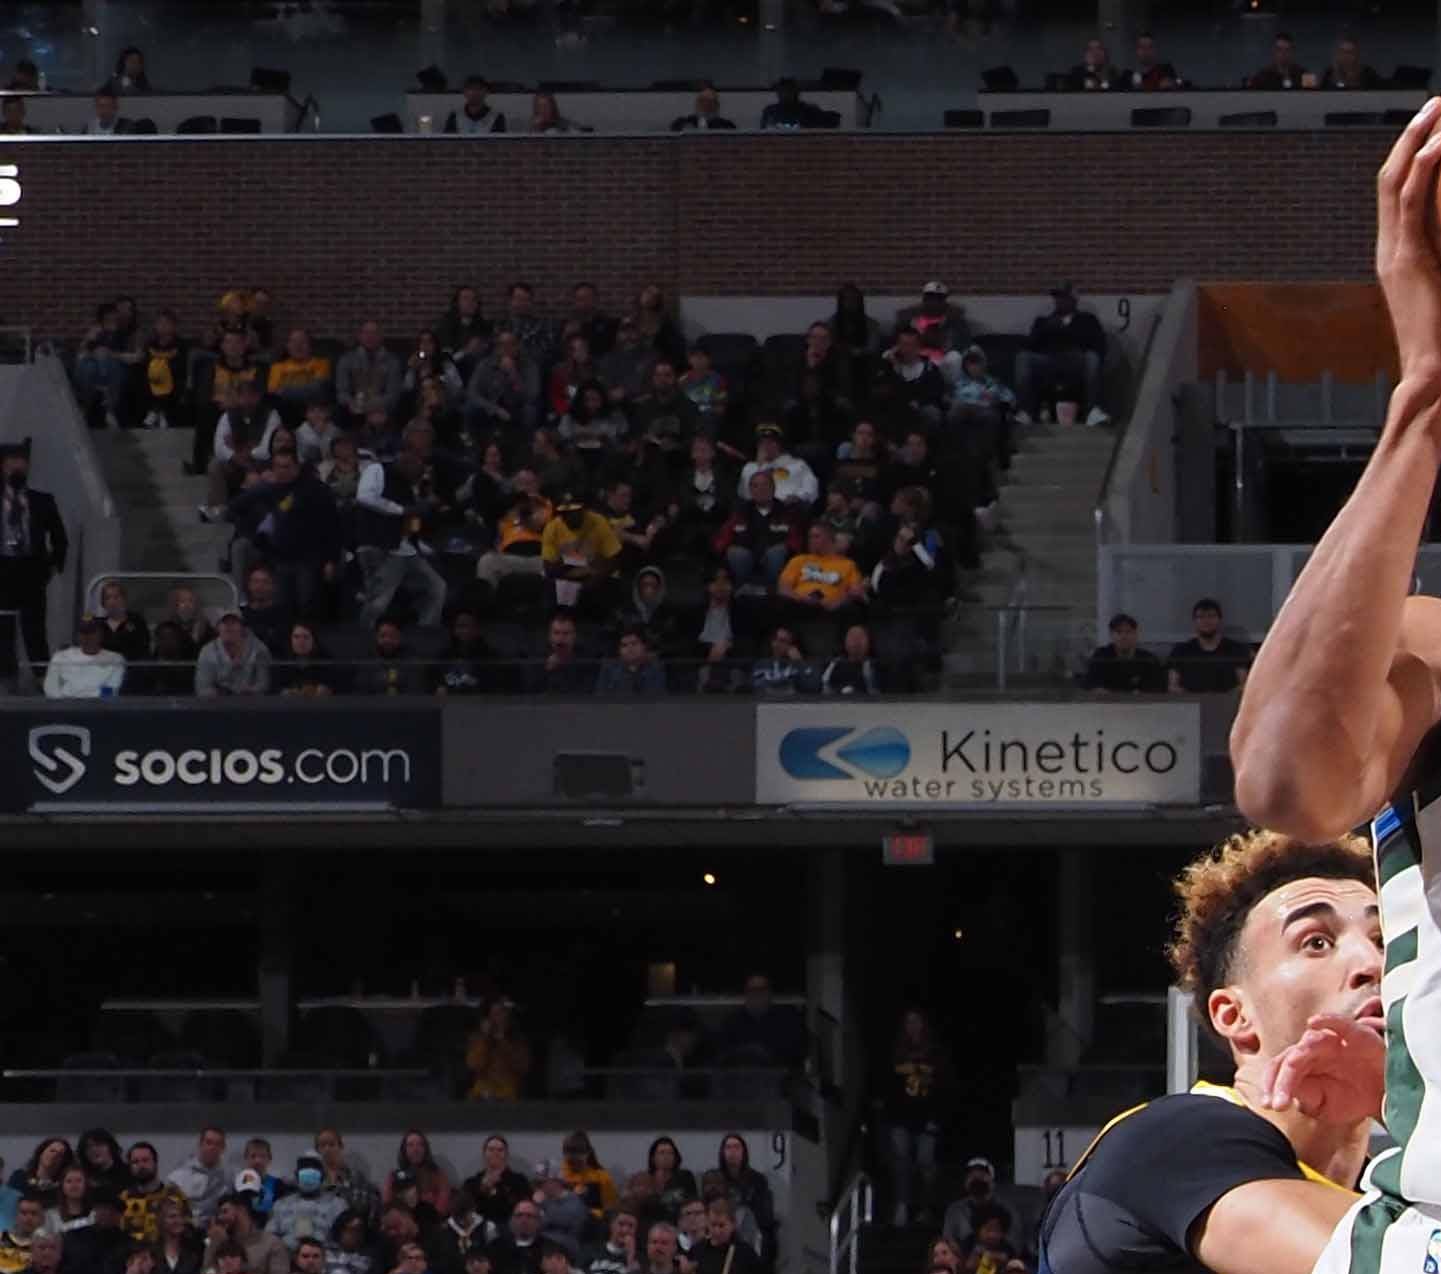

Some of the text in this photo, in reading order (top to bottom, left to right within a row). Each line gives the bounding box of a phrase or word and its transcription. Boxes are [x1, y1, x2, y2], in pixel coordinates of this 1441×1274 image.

[1117, 298, 1131, 332] 9
[941, 729, 1179, 774] Kinetico
[864, 777, 1104, 802] water systems
[772, 1130, 786, 1171] 9
[1042, 1131, 1067, 1168] 11
